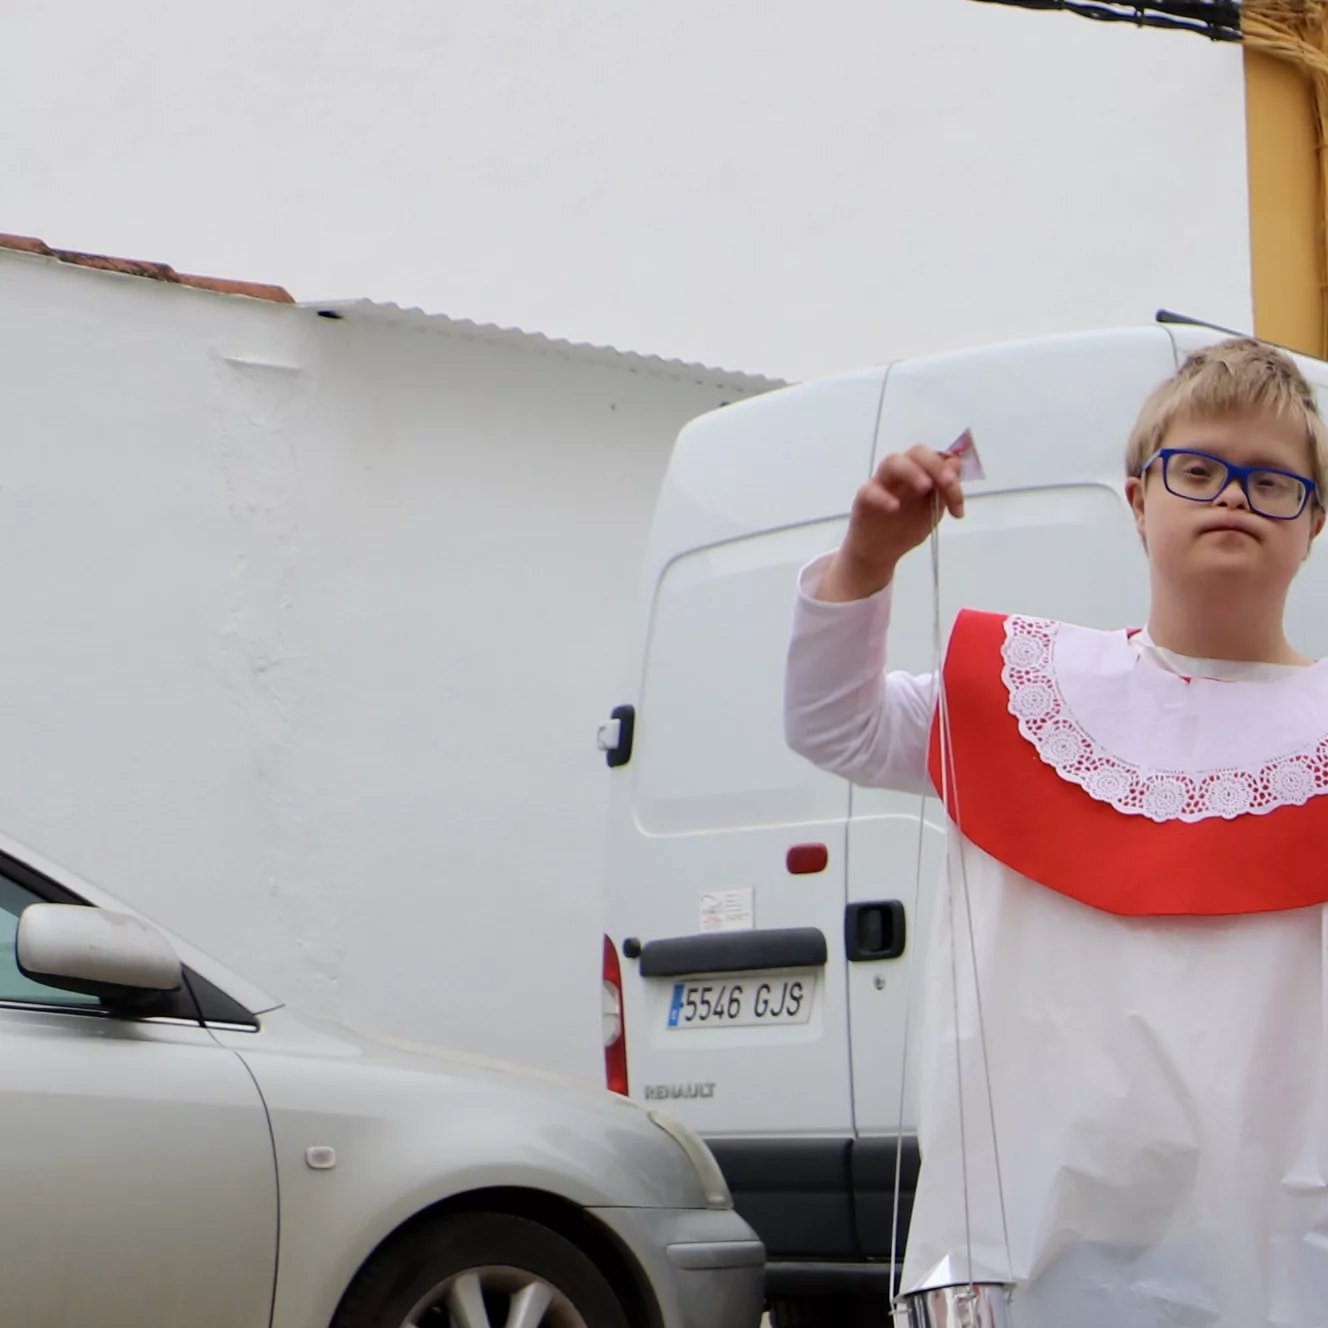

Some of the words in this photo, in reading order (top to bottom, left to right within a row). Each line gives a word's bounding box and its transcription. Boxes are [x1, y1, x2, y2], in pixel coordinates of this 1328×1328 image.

[684, 984, 743, 1021] 5546
[753, 981, 803, 1017] GJS
[643, 1081, 716, 1100] RENAULT
